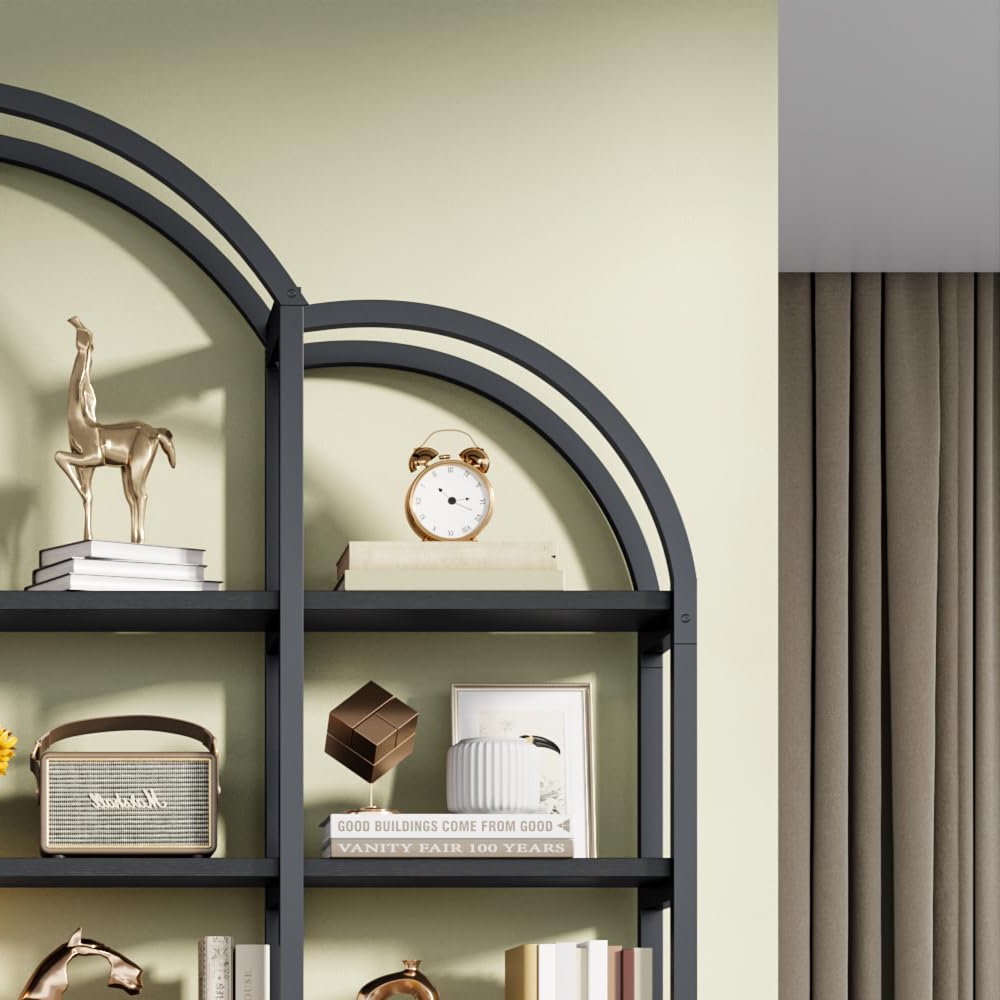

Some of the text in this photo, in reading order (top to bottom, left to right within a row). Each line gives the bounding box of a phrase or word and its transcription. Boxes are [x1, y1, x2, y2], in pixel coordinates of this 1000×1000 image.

[337, 820, 370, 832] GOOD
[375, 820, 438, 832] BUILDINGS
[442, 820, 477, 832] COME
[481, 820, 516, 832] FROM
[520, 820, 553, 832] GOOD
[338, 843, 566, 853] VANITY FAIR 100 YEARS
